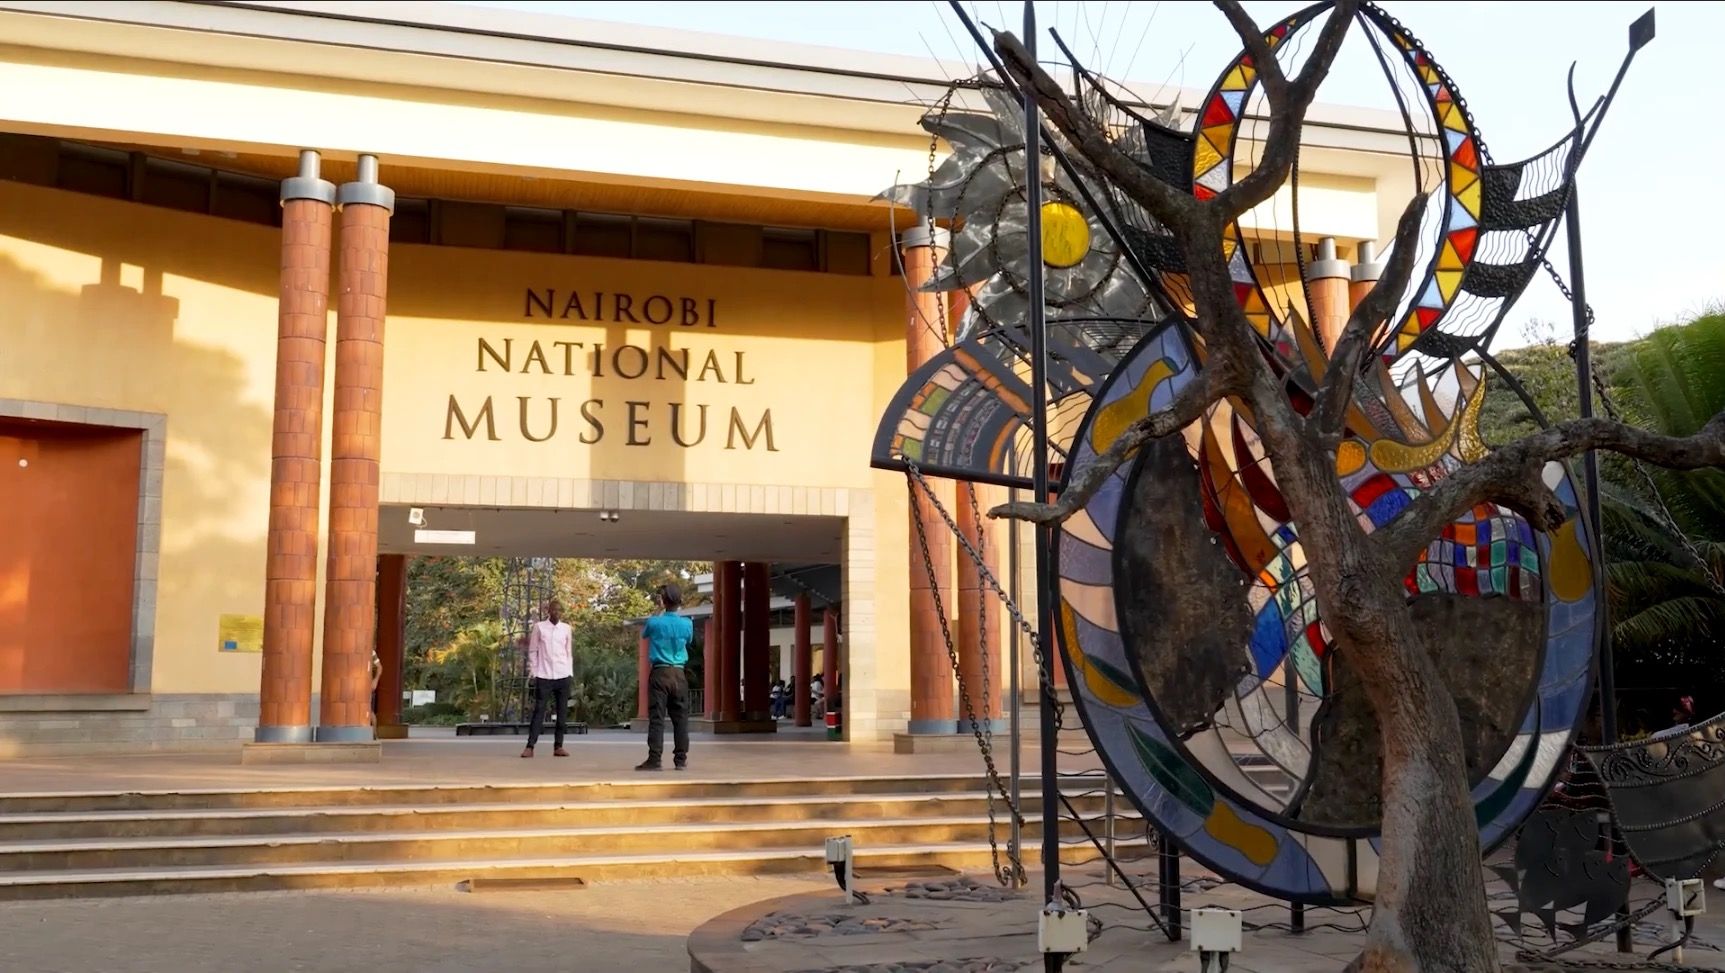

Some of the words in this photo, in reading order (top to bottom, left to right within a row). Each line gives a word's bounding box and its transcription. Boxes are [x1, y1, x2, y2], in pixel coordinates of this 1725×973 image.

[524, 287, 717, 328] NAIROBI
[476, 337, 755, 385] NATIONAL
[441, 394, 780, 452] MUSEUM
